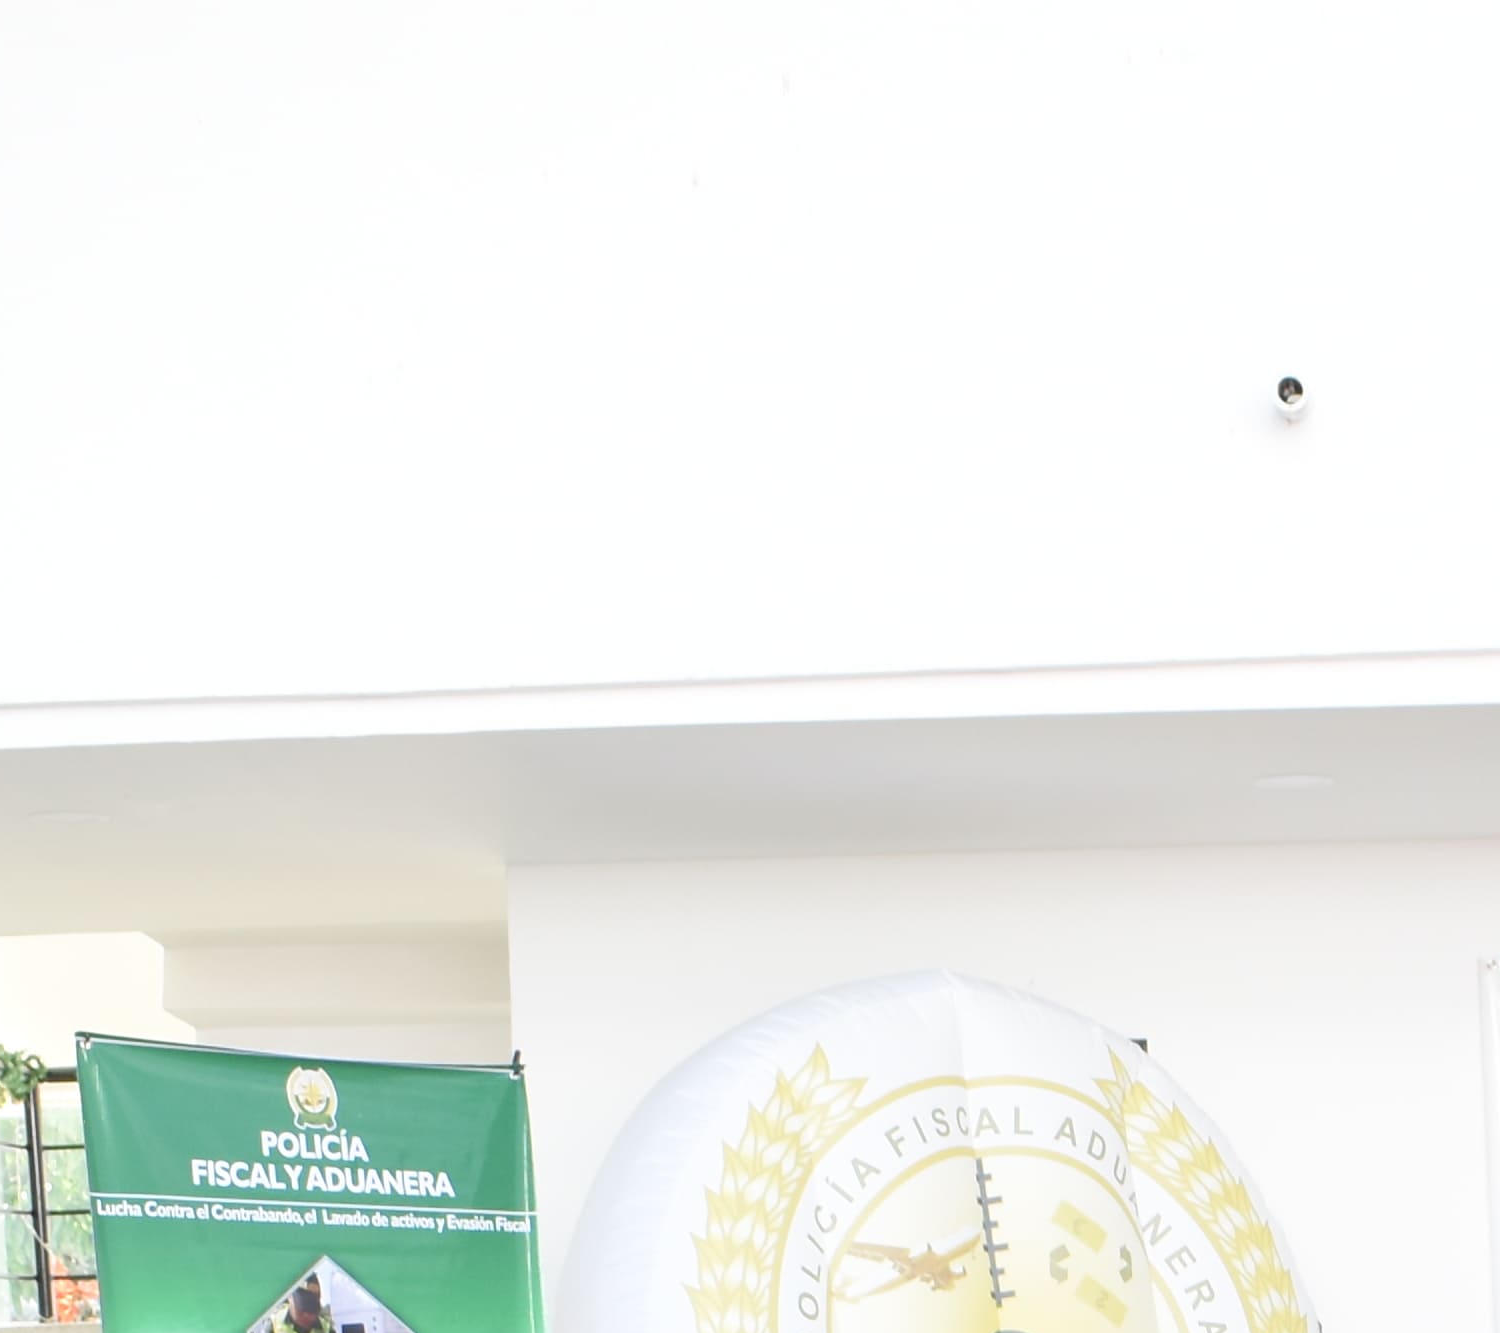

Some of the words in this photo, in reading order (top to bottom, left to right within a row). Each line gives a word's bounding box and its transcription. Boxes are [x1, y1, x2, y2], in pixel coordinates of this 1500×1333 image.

[261, 1128, 370, 1162] POLICÍA
[884, 1106, 1034, 1158] FISCAL
[191, 1159, 287, 1190] FISCAL
[283, 1163, 303, 1191] Y
[306, 1165, 456, 1198] ADUANERA
[96, 1199, 143, 1218] Lucha
[144, 1200, 196, 1220] Contra
[196, 1203, 210, 1220] el
[322, 1209, 370, 1228] Lavado
[371, 1211, 389, 1228] de
[390, 1212, 436, 1230] activos
[435, 1217, 446, 1233] y
[446, 1214, 494, 1232] Evasión
[495, 1216, 531, 1233] Fiscal
